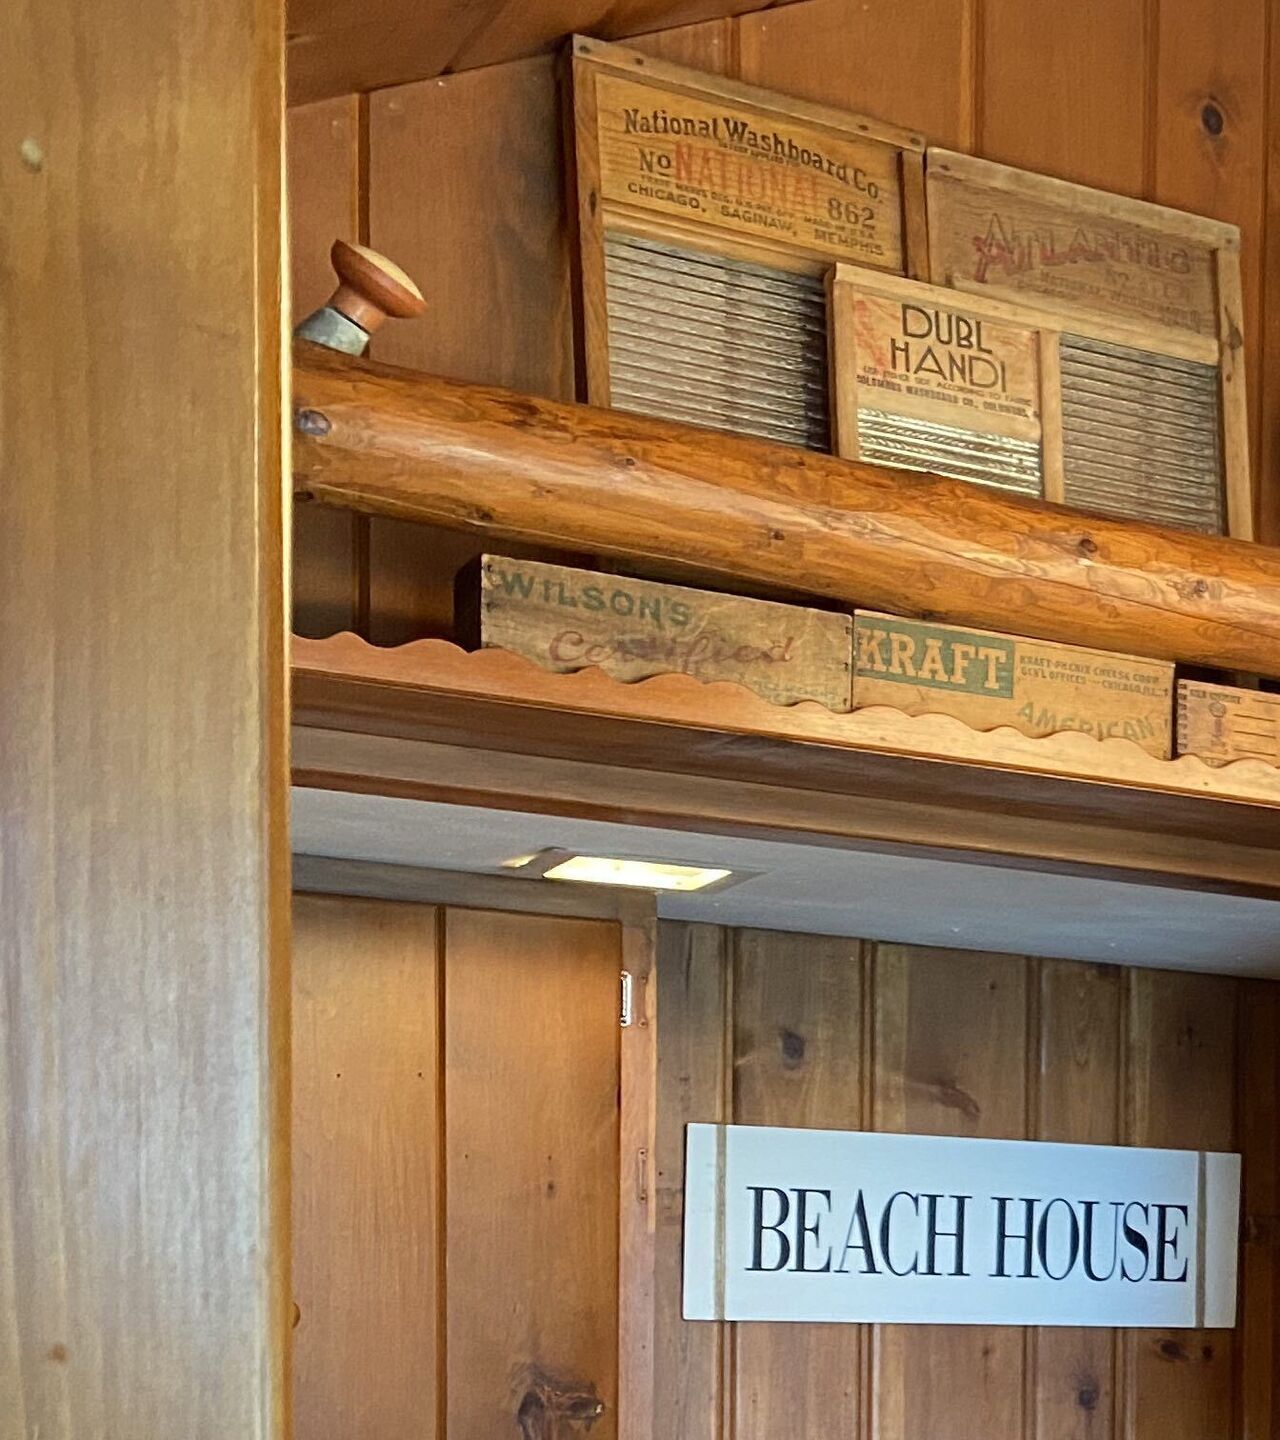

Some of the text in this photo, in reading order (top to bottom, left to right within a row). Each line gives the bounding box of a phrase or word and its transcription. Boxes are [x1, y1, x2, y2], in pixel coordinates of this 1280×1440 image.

[622, 108, 885, 203] National Washboard Co.
[627, 181, 886, 257] CHICAGO, SAGINAW, MEMPHIS
[827, 197, 876, 231] 862
[901, 303, 993, 355] DUBL
[890, 338, 1008, 394] HANDI
[500, 569, 694, 629] WILSON'S
[856, 627, 1007, 690] KRAFT
[1017, 700, 1156, 742] AMERICAN
[744, 1185, 1189, 1284] BEACH HOUSE
